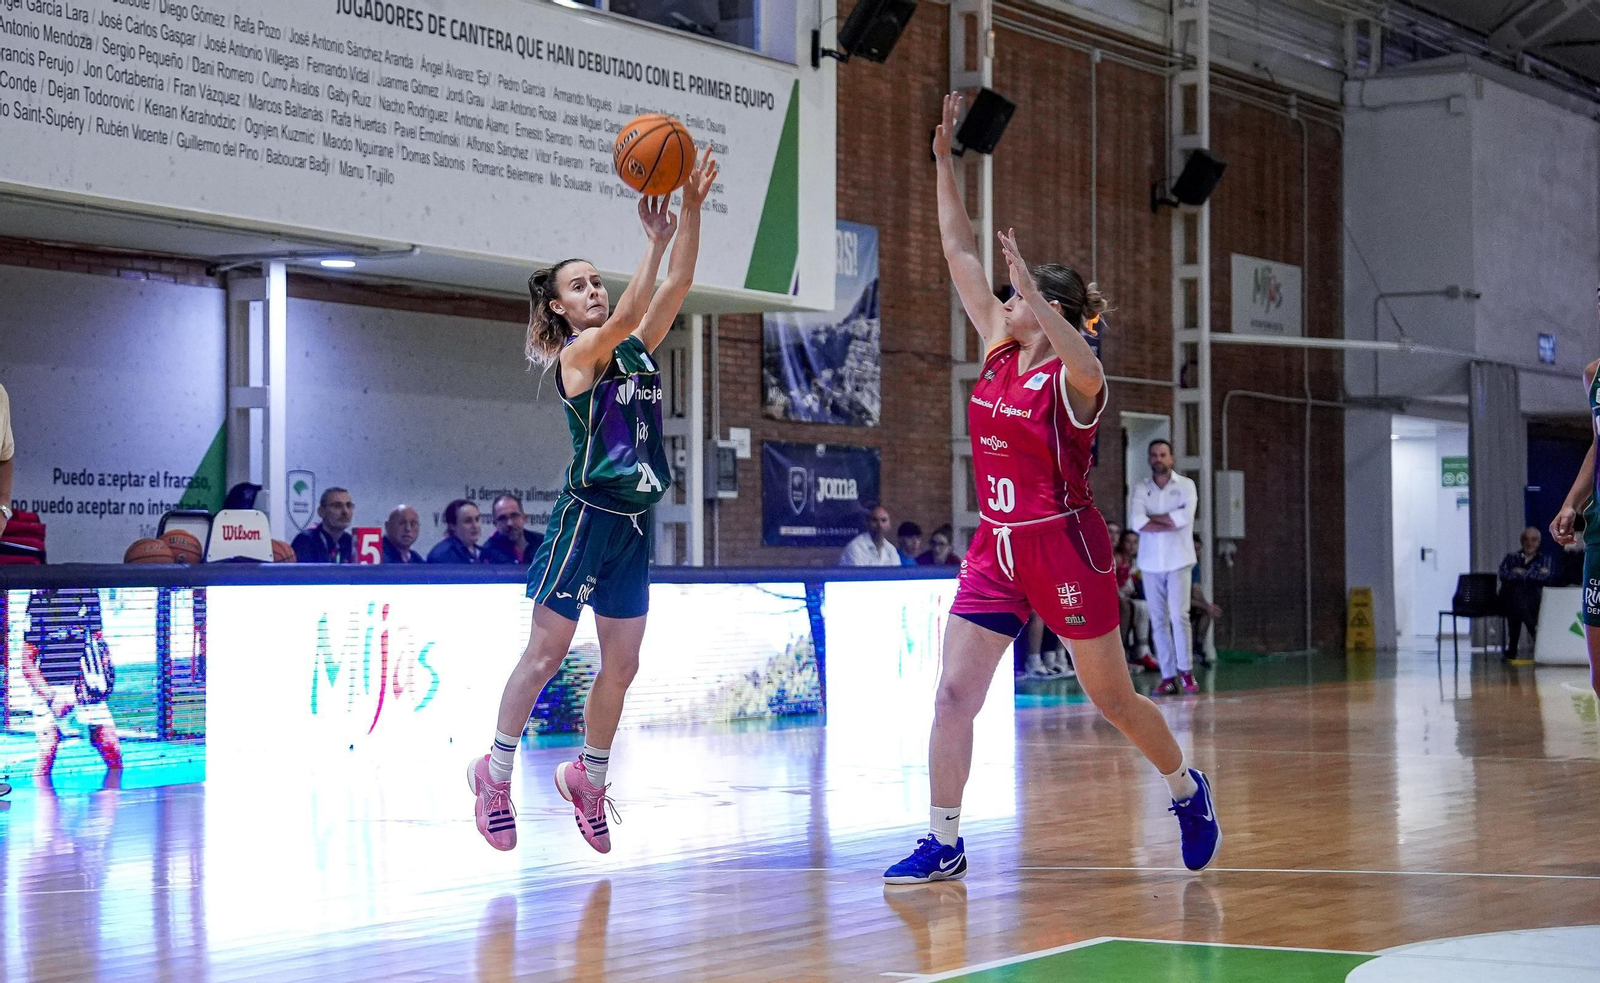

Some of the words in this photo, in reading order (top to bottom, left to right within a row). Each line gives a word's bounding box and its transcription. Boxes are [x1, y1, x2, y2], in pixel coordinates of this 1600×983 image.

[0, 16, 39, 40] Antonio
[42, 24, 92, 50] Mendoza
[101, 36, 135, 62] Sergio
[138, 44, 183, 69] Pequeño
[191, 55, 214, 75] Dani
[216, 61, 254, 84] Romero
[65, 2, 88, 23] Lara
[98, 10, 122, 30] José
[125, 15, 157, 38] Carlos
[160, 23, 196, 48] Gaspar
[203, 34, 226, 53] José
[227, 39, 263, 61] Antonio
[159, 0, 188, 22] Diego
[190, 4, 225, 28] Gómez
[233, 14, 255, 34] Rafa
[257, 19, 281, 40] Pozo
[288, 27, 309, 46] José
[335, 0, 424, 32] JUGADORES
[427, 13, 447, 37] DE
[449, 18, 513, 53] CANTERA
[516, 34, 543, 60] QUE
[546, 41, 574, 67] HAN
[578, 49, 642, 82] DEBUTADO
[645, 64, 669, 88] CON
[673, 70, 685, 91] EL
[688, 74, 732, 101] PRIMER
[734, 84, 774, 111] EQUIPO
[0, 47, 34, 66] rancis
[38, 50, 74, 77] Perujo
[82, 59, 102, 79] Jon
[105, 63, 164, 91] Cortaberría
[173, 77, 196, 97] Fran
[198, 82, 240, 107] Vázquez
[248, 92, 282, 114] Marcos
[330, 108, 351, 128] Rafa
[0, 70, 36, 93] Conde
[47, 78, 79, 103] Dejan
[144, 97, 177, 119] Kenan
[13, 100, 85, 135] Saint-Supéry
[96, 116, 128, 138] Rubén
[131, 123, 168, 145] Vicente
[222, 140, 237, 157] del
[238, 142, 259, 161] Pino
[339, 159, 364, 179] Manu
[54, 468, 94, 486] Puedo
[149, 472, 160, 488] el
[77, 500, 125, 519] aceptar
[129, 502, 144, 515] no
[222, 525, 261, 541] Wilson
[359, 534, 380, 564] 5
[312, 601, 441, 734] Mijas
